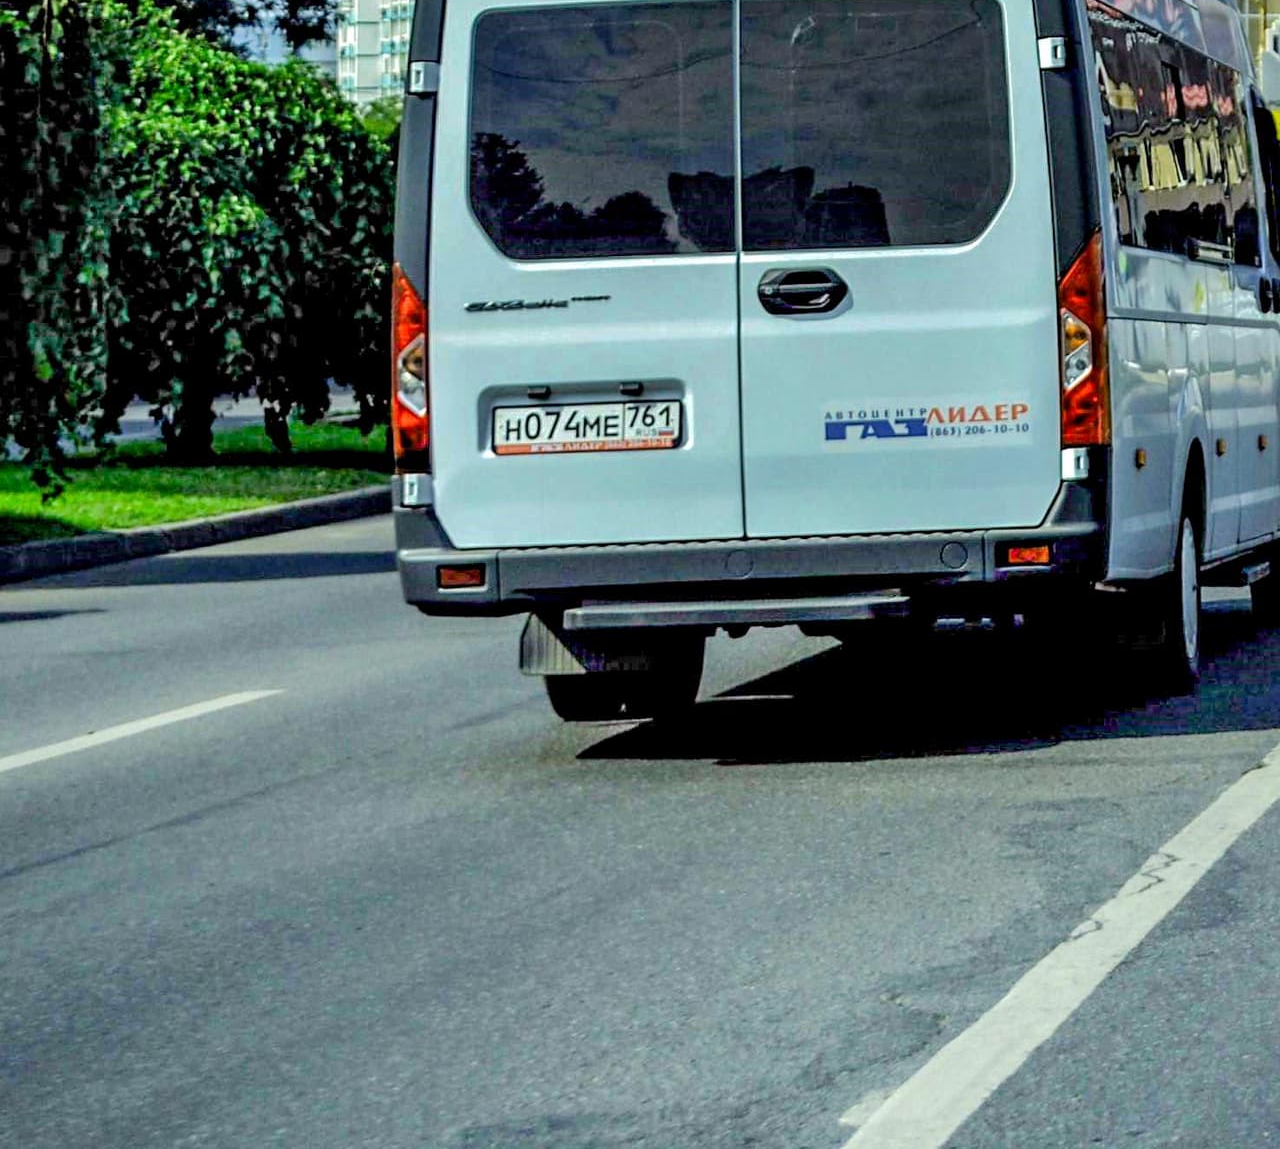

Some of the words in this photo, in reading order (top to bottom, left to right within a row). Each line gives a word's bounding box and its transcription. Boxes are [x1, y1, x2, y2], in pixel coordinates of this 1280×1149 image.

[626, 405, 673, 428] 761
[824, 407, 928, 420] АВТОЦЕНТР
[926, 403, 1029, 424] ЛИДЕР
[824, 417, 928, 441] ГАЗ
[965, 422, 1030, 436] 206-10-10
